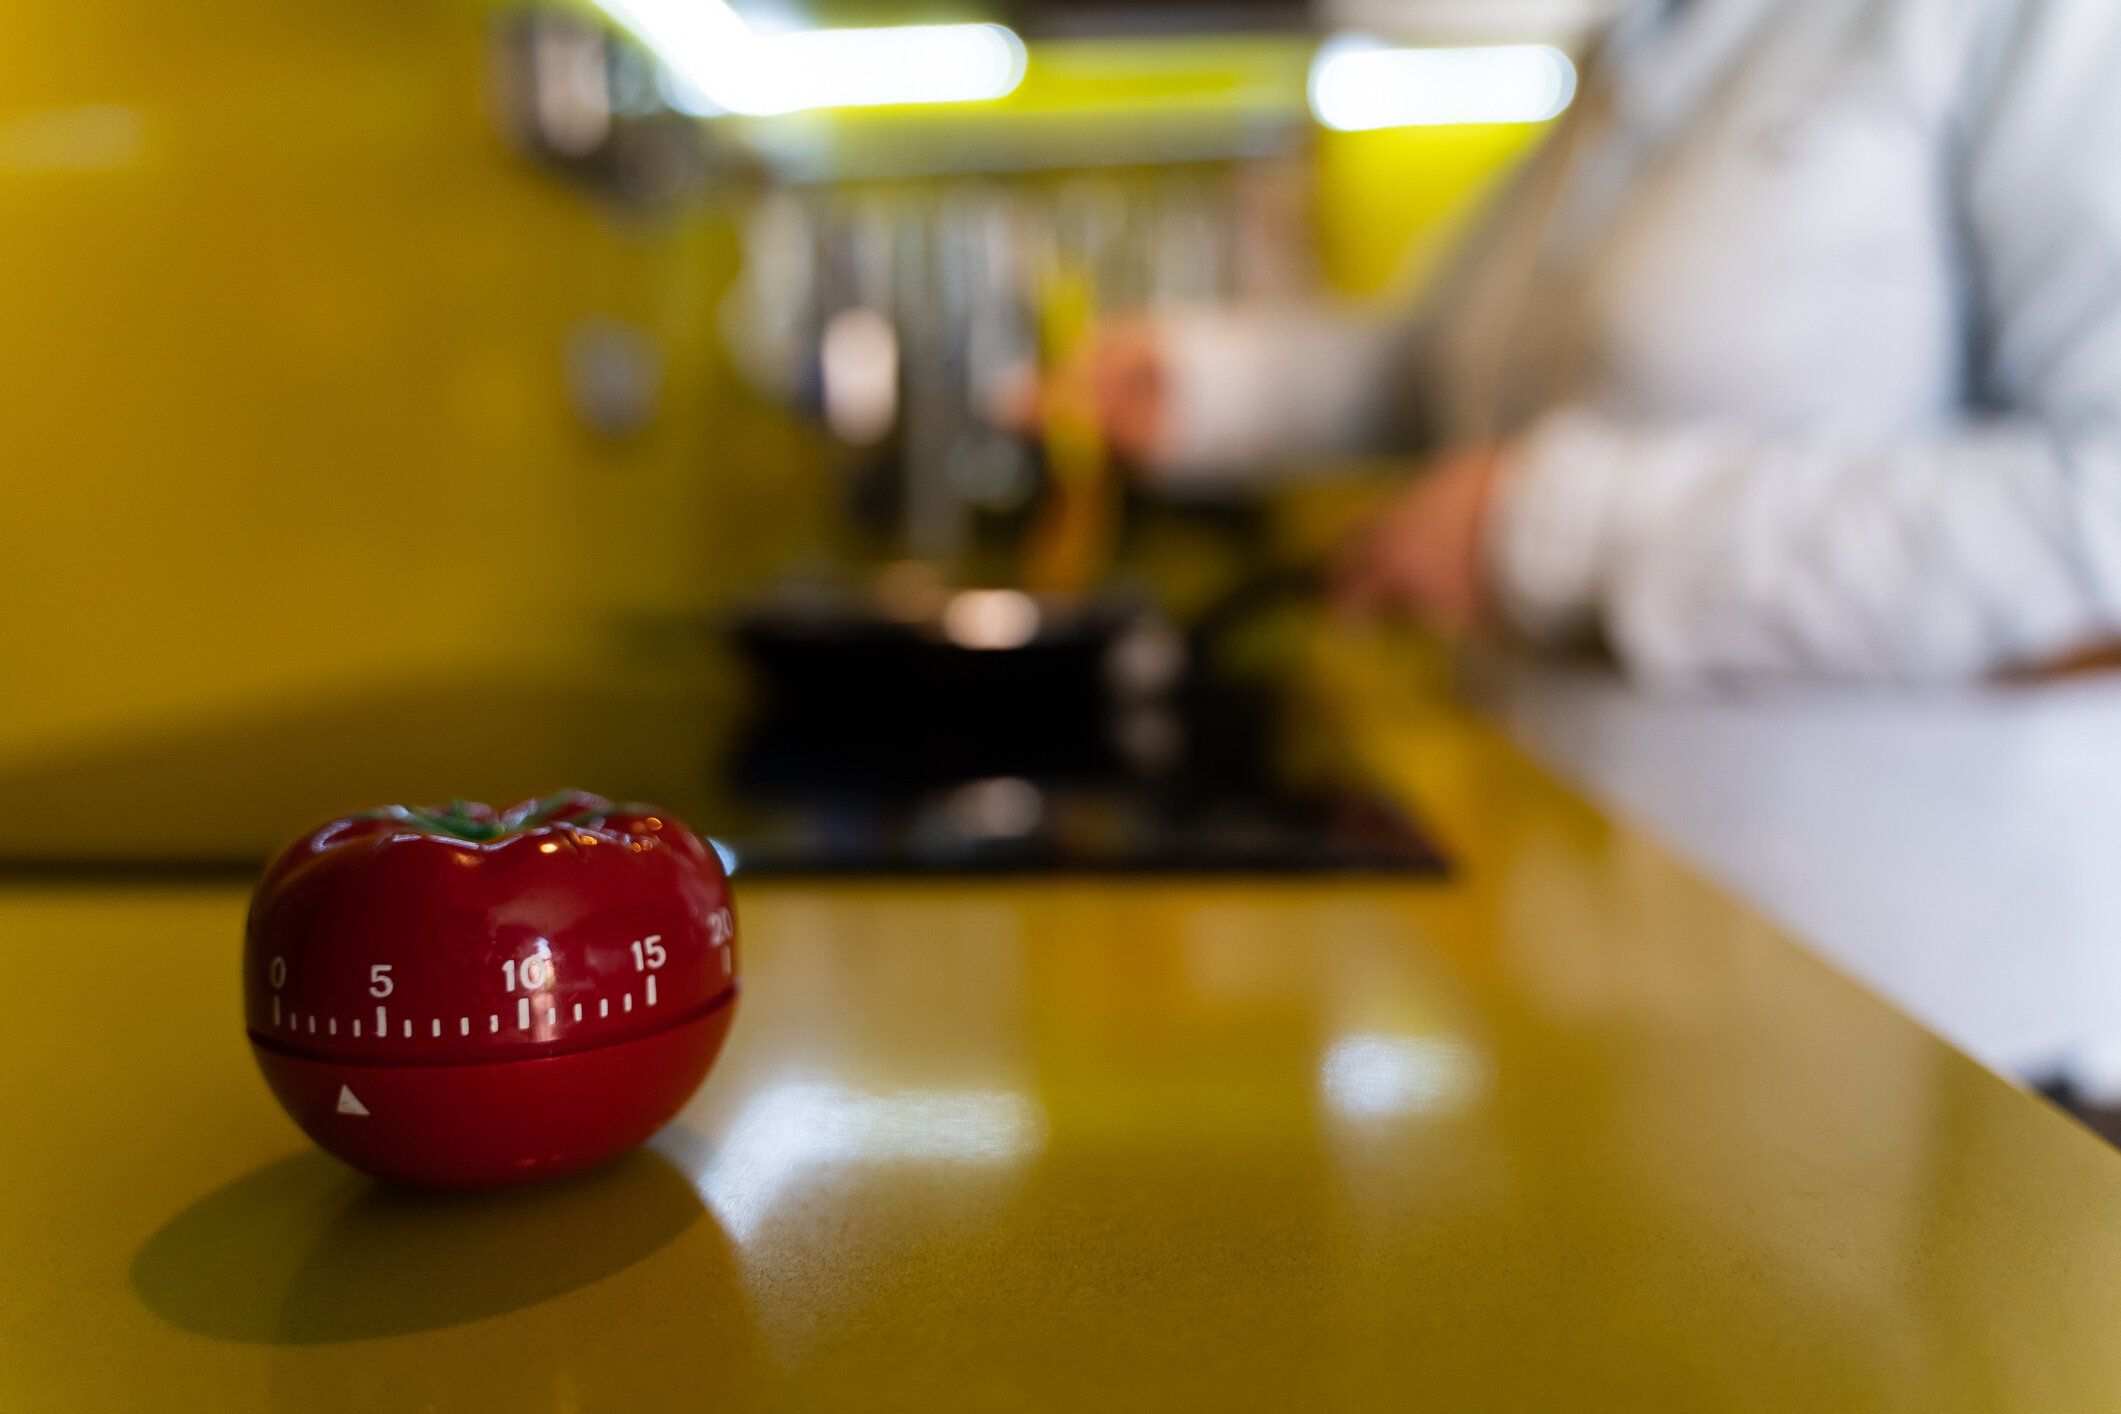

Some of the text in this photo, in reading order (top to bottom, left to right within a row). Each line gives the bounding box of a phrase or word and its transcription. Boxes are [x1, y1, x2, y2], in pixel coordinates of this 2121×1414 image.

[271, 907, 734, 998] 0 5 10 15 20
